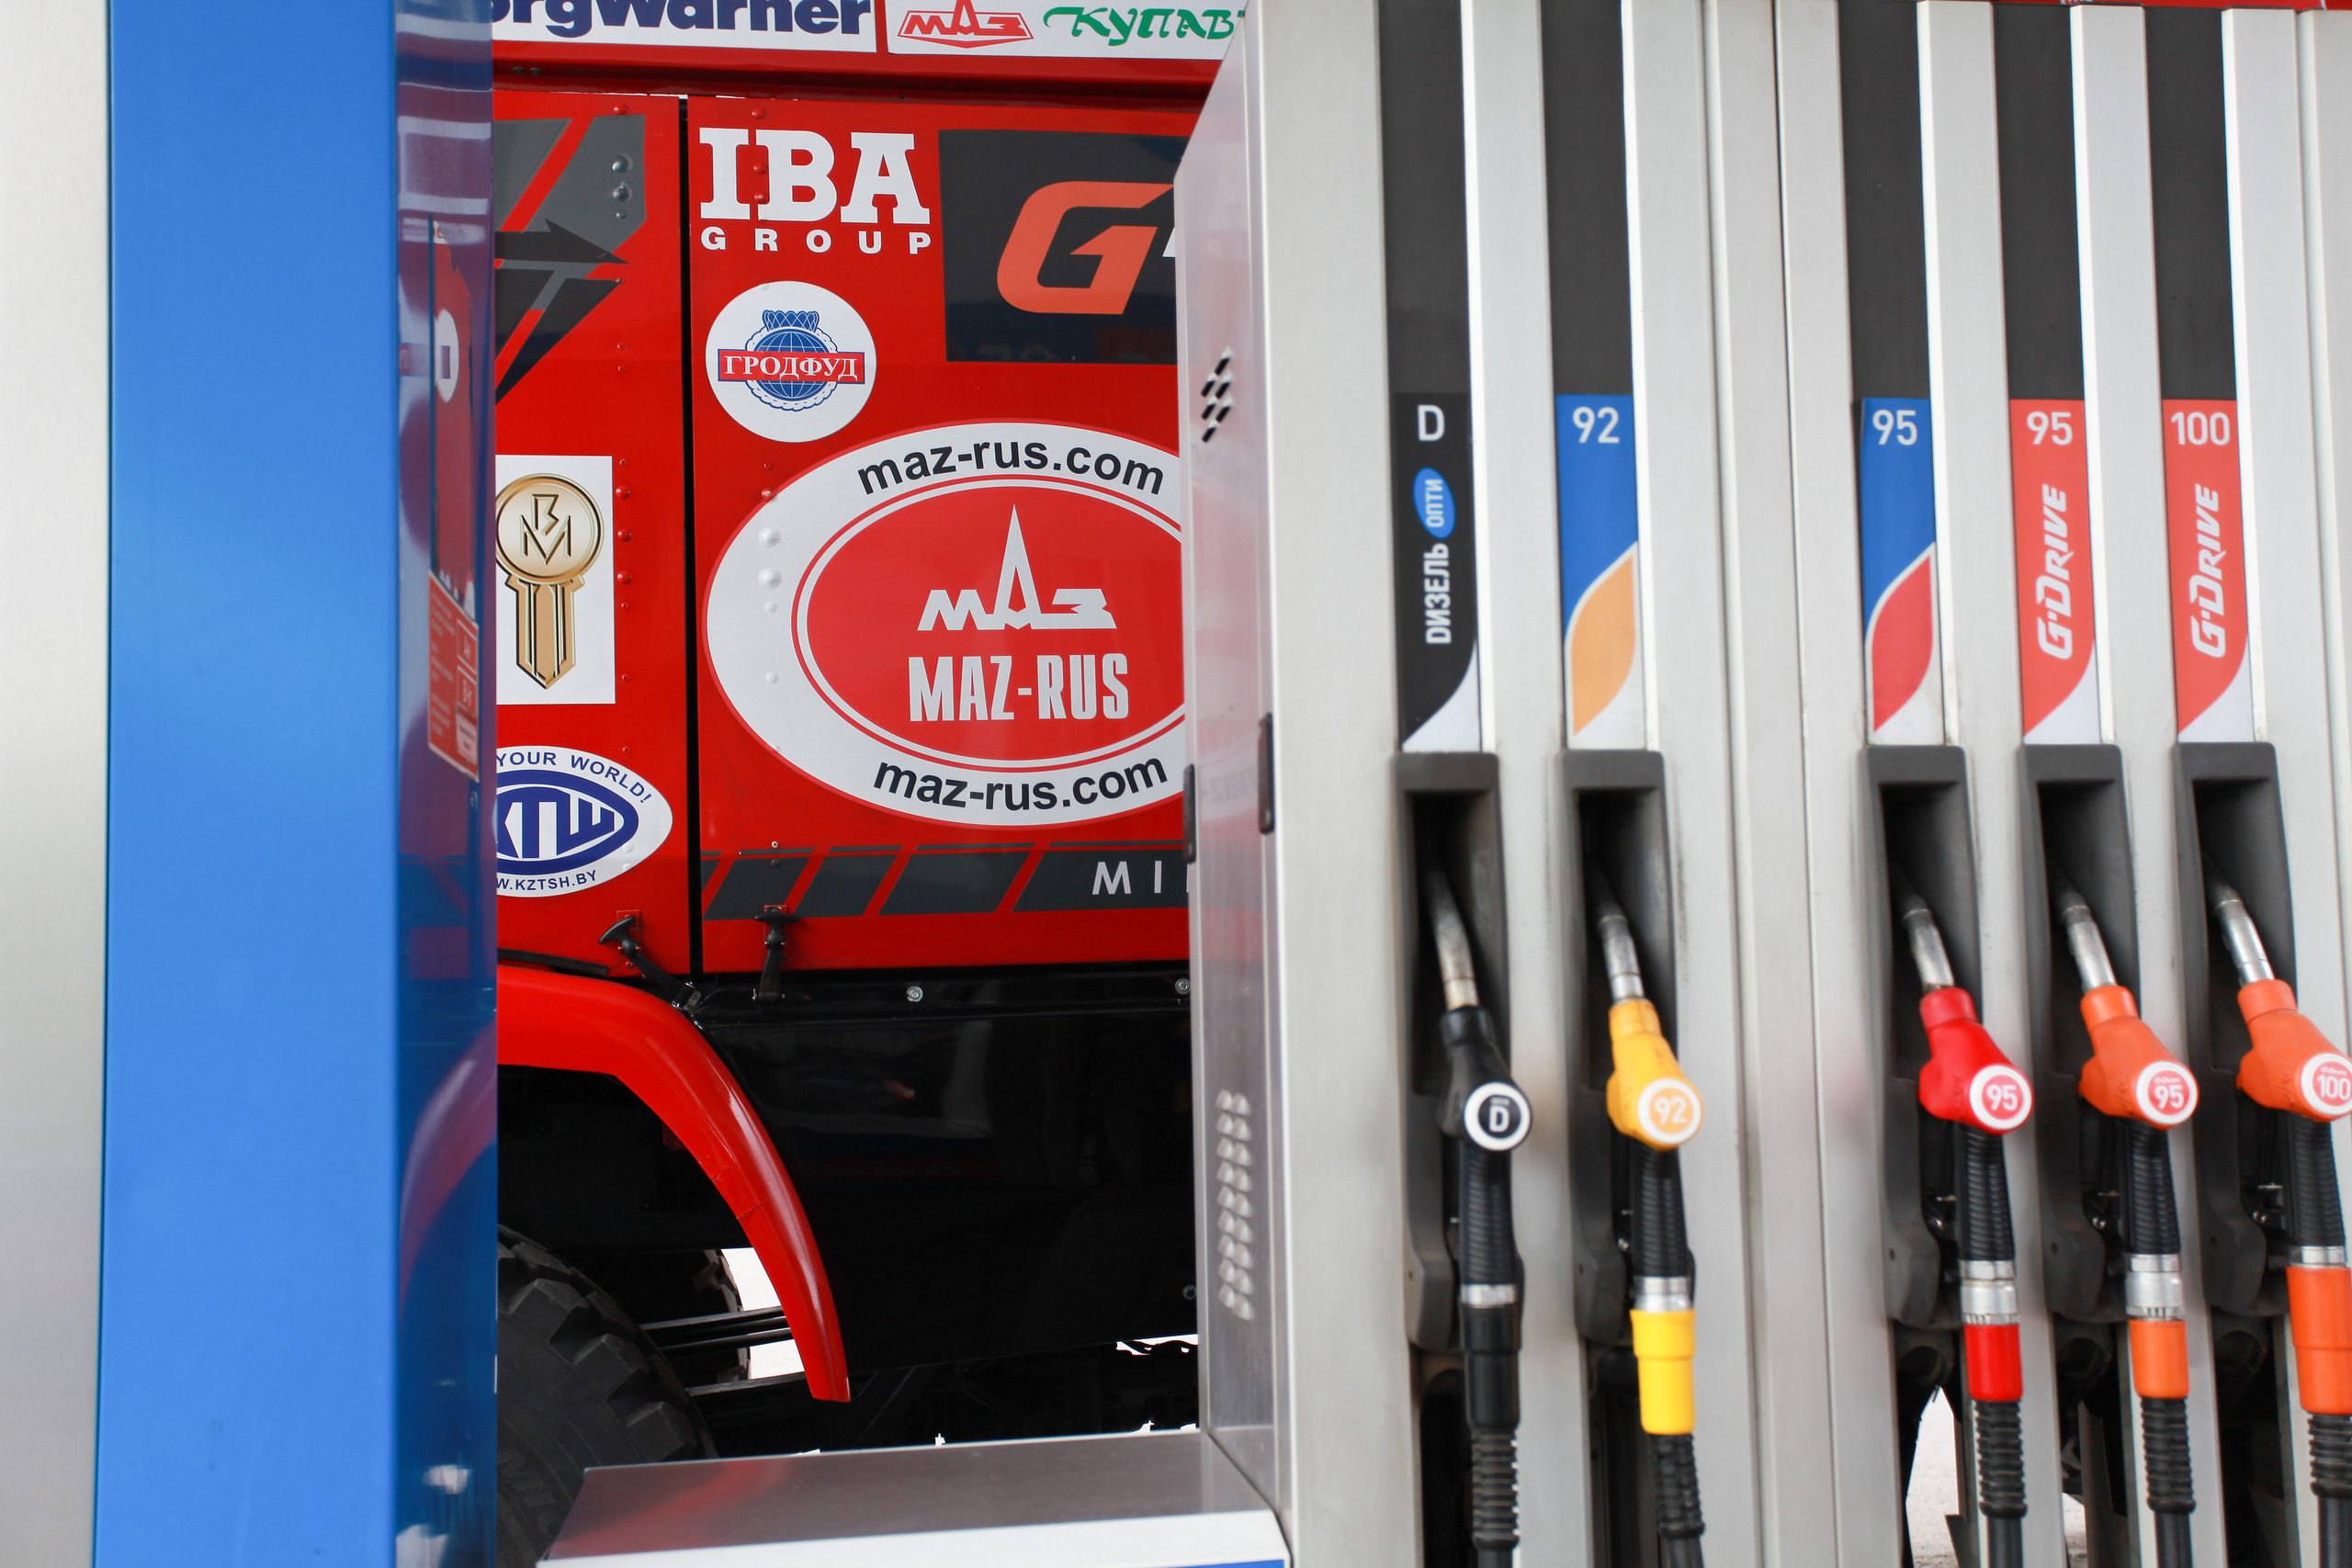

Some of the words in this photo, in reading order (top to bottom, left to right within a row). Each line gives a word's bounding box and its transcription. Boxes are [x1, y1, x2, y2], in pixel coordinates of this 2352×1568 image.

[492, 0, 871, 38] rgWarner
[1044, 6, 1244, 46] КУПАВ
[699, 127, 931, 225] IBA
[701, 226, 932, 254] GROUP
[724, 355, 858, 381] ГРОДФУД
[1417, 405, 1445, 441] D
[1572, 406, 1620, 443] 92
[1872, 410, 1917, 446] 95
[2026, 412, 2073, 446] 95
[2171, 412, 2231, 446] 100
[857, 440, 1164, 495] maz-rus.com
[1425, 479, 1445, 528] ОПТИ
[908, 653, 1129, 722] MAZ-RUS
[571, 754, 652, 804] WORLD!
[873, 758, 1168, 811] maz-rus.com
[1091, 860, 1189, 895] MI
[1986, 1084, 2018, 1111] 95
[2154, 1085, 2185, 1109] 95
[2316, 1075, 2351, 1100] 100
[1488, 1105, 1510, 1133] D
[1655, 1096, 1688, 1124] 92
